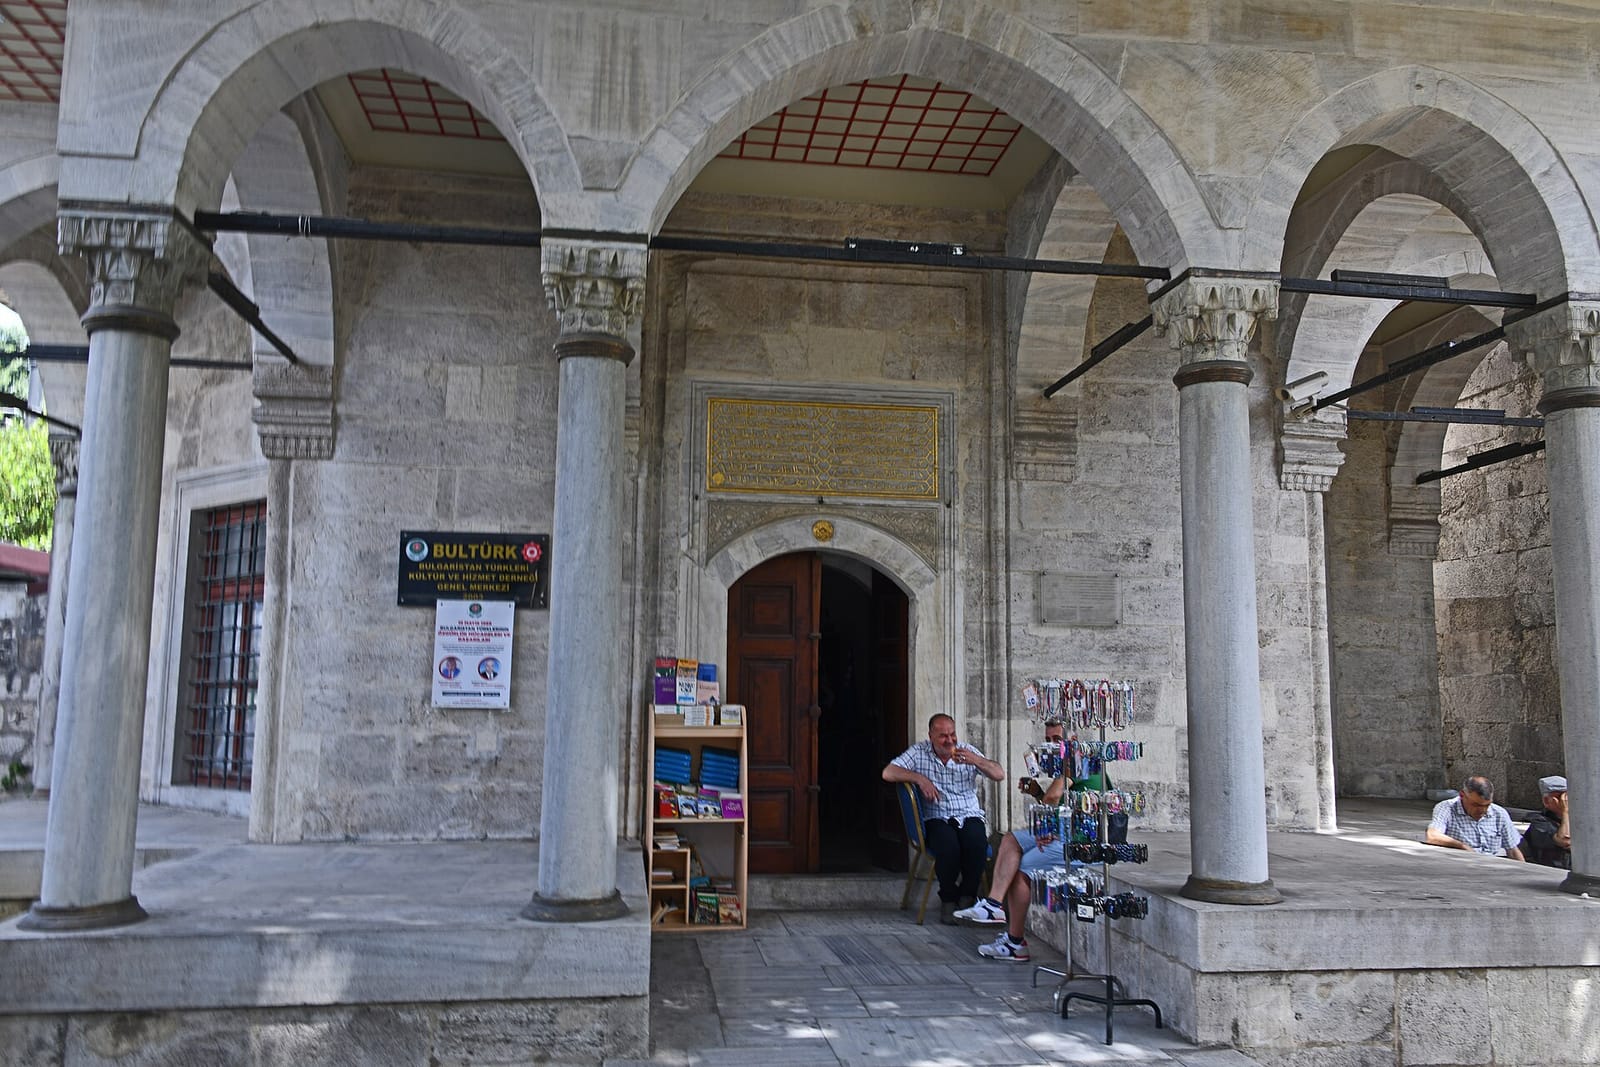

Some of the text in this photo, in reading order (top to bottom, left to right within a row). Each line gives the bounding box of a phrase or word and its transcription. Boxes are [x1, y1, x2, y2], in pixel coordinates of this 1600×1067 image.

[432, 540, 518, 560] BULTÜRK
[418, 562, 529, 573] BULGARİSTAN TÜRKLERİ
[408, 572, 538, 583] KÜLTÜR VE HİZMET DERNEĞİ
[437, 583, 510, 592] GENEL MERKEZİ
